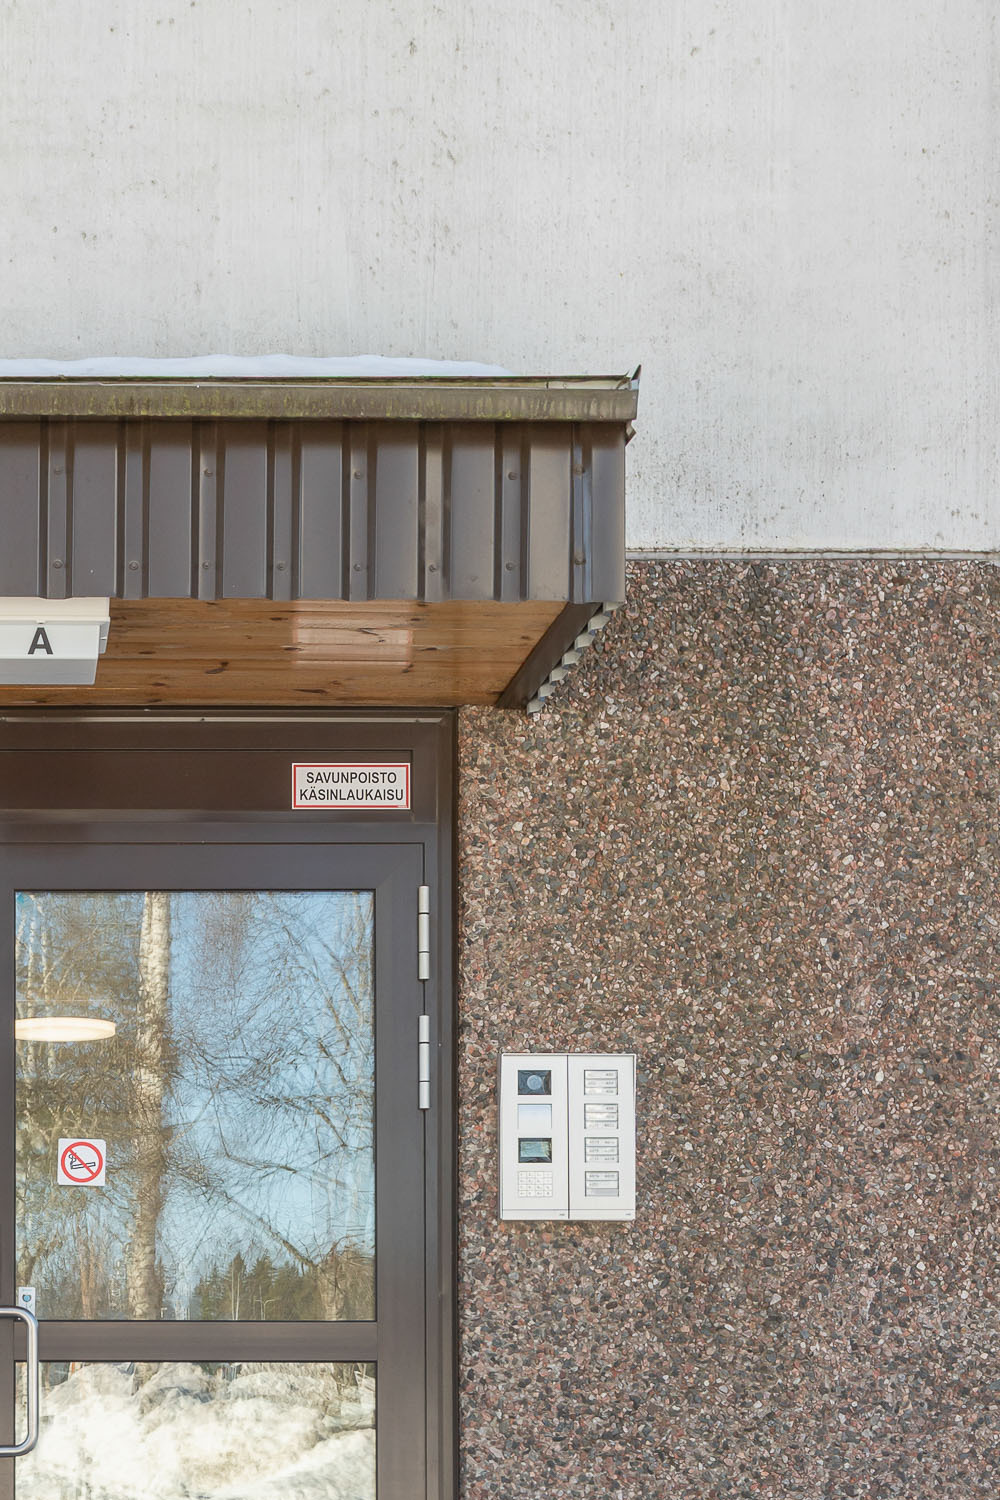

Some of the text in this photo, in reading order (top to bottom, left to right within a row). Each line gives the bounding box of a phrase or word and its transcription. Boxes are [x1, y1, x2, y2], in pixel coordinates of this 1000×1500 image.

[27, 627, 54, 655] A
[306, 771, 397, 784] SAVUNPOISTO
[299, 786, 404, 801] KÄSINLAUKAISU
